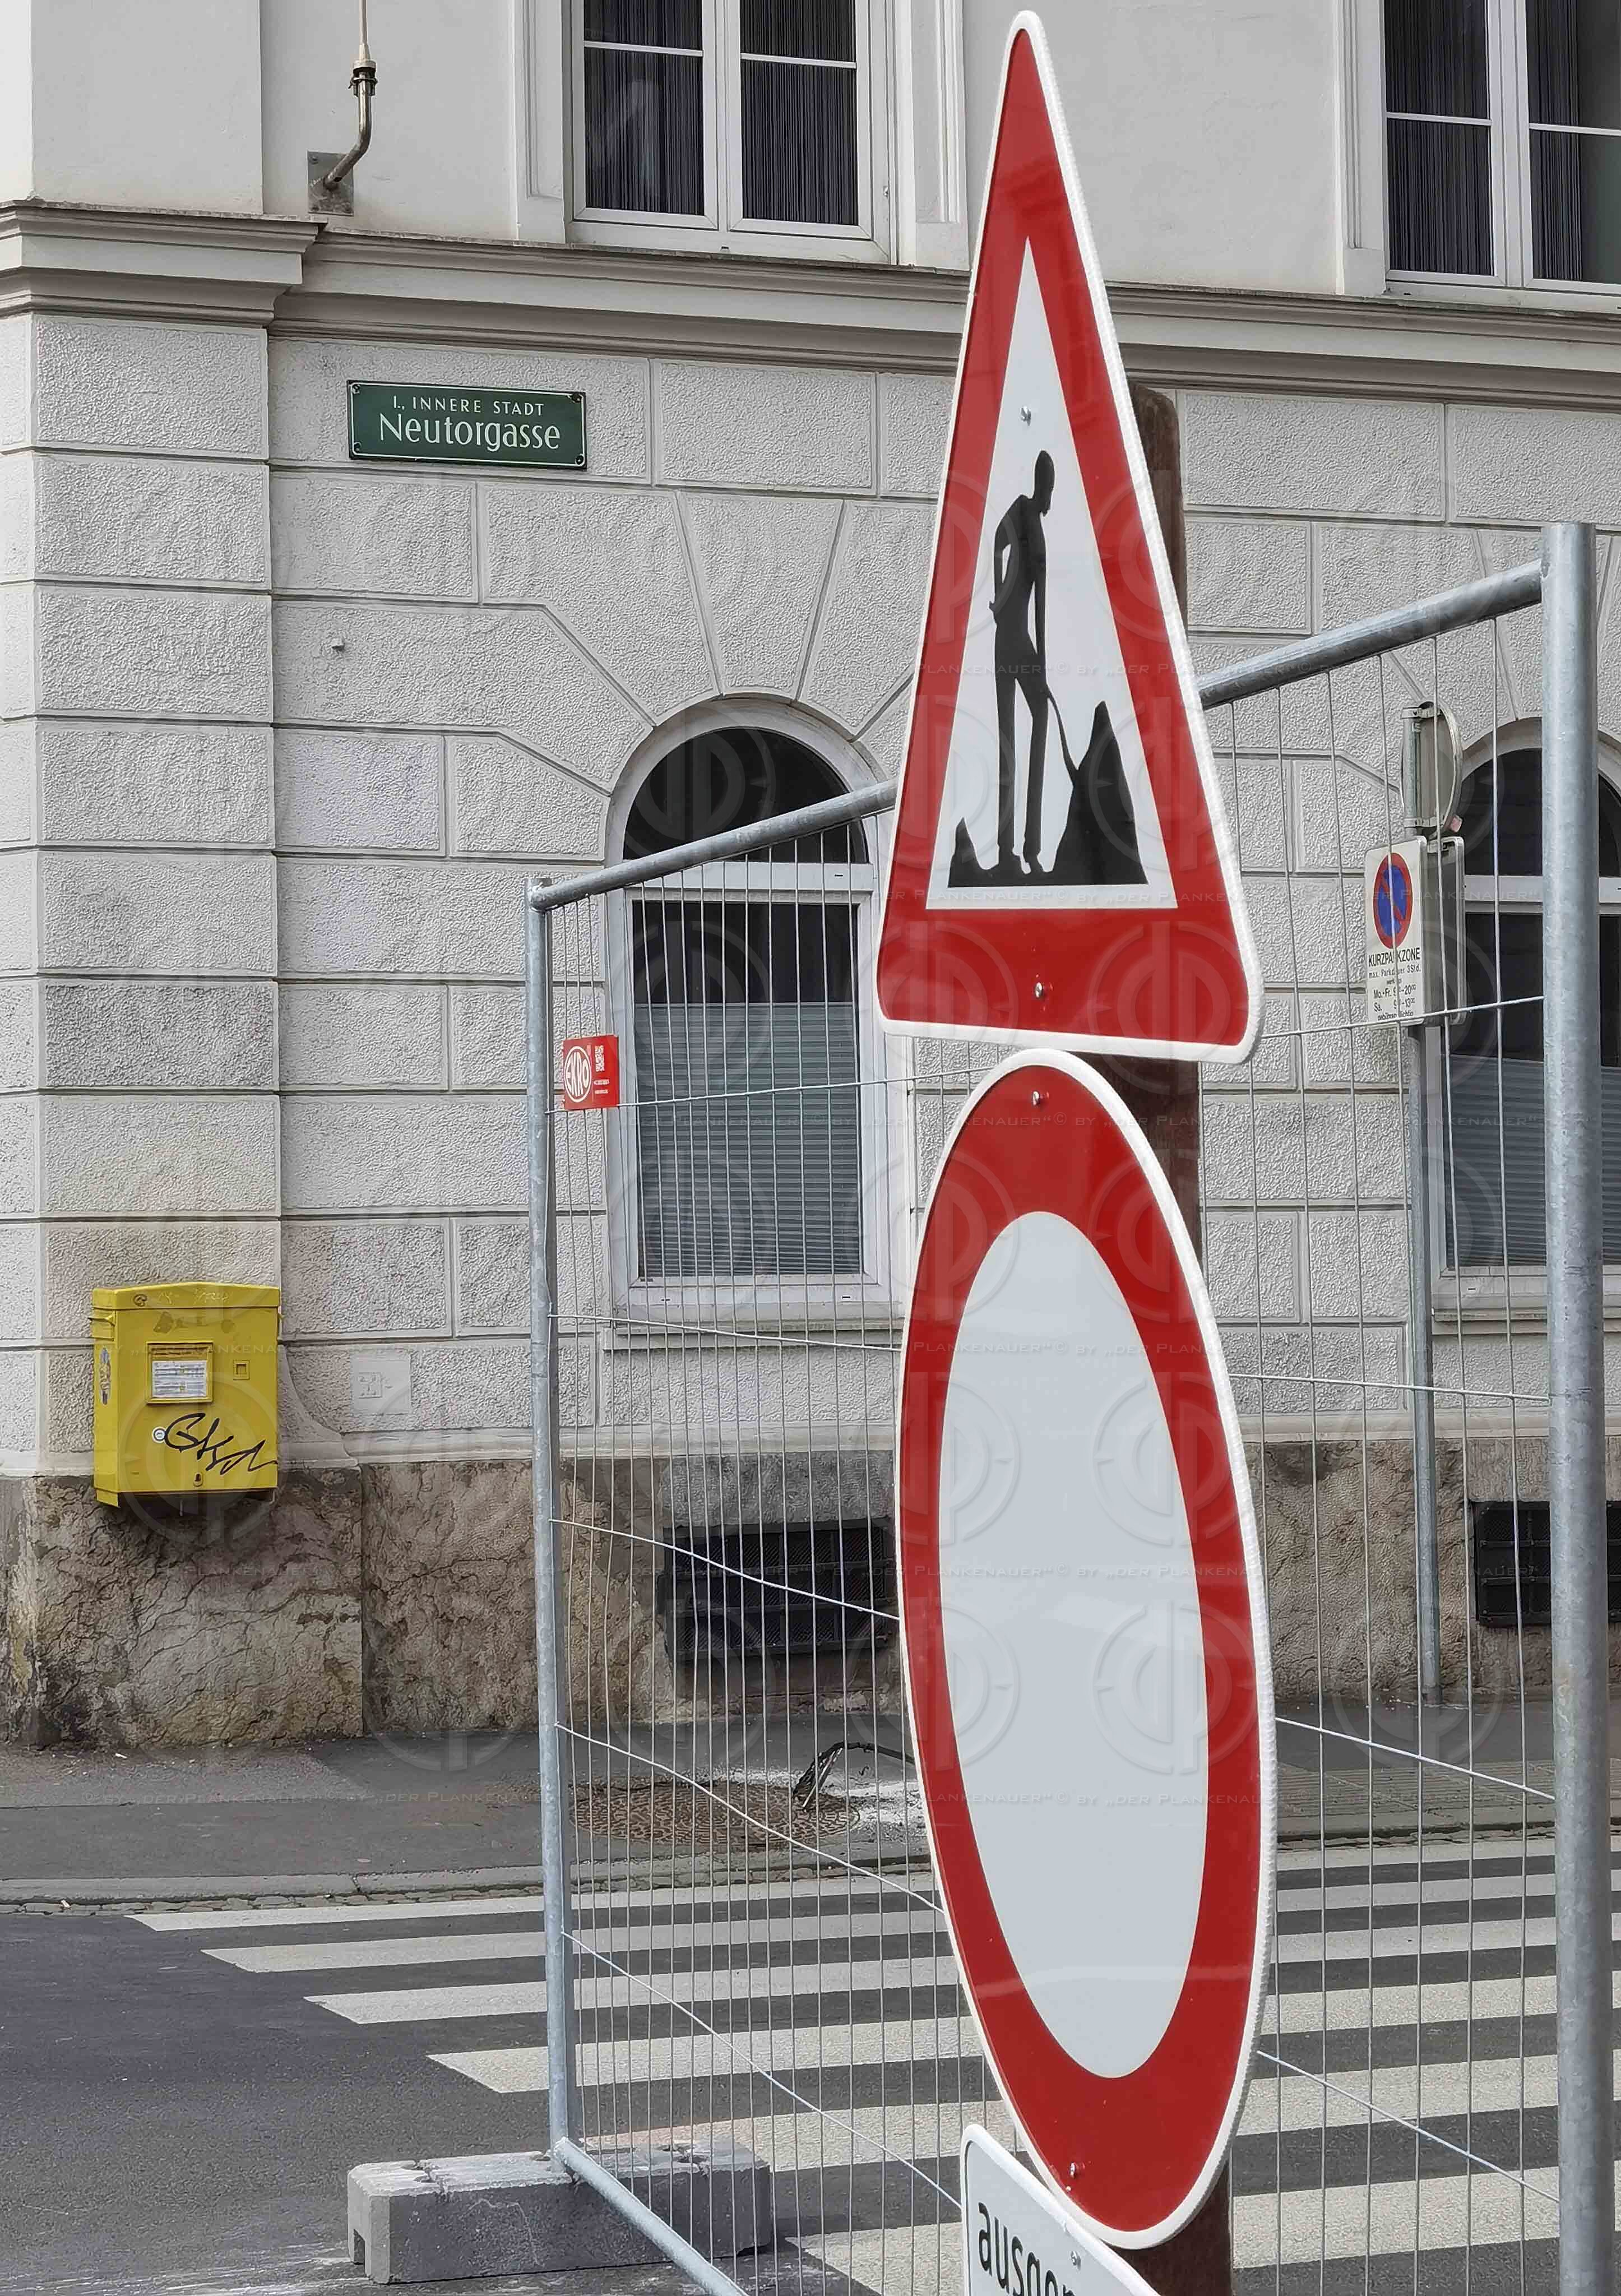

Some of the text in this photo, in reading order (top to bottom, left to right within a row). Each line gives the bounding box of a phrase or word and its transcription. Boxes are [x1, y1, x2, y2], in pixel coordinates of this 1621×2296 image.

[413, 397, 481, 413] INNERE
[493, 401, 544, 416] STADT
[379, 413, 561, 452] Neutorgasse
[1368, 947, 1420, 967] KURZPAKZONE
